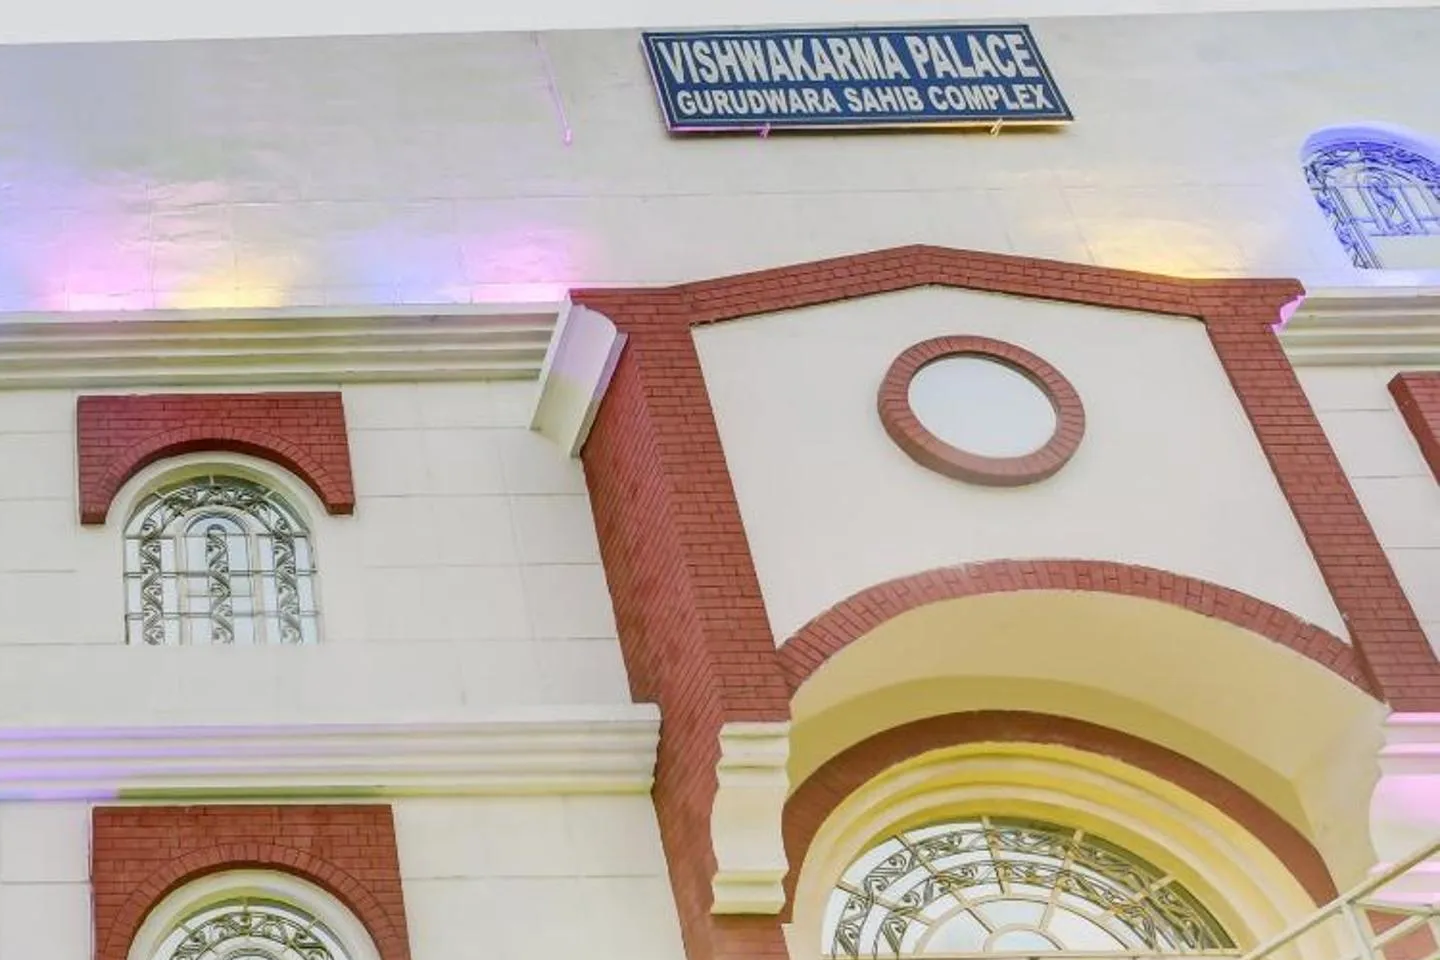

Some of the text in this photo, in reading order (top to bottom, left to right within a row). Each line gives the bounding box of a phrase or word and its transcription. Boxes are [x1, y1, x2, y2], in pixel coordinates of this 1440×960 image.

[661, 34, 1040, 85] VISHWAKARMA PALACE
[677, 85, 1054, 116] GURUDWARA SAHIB COMPLEX
